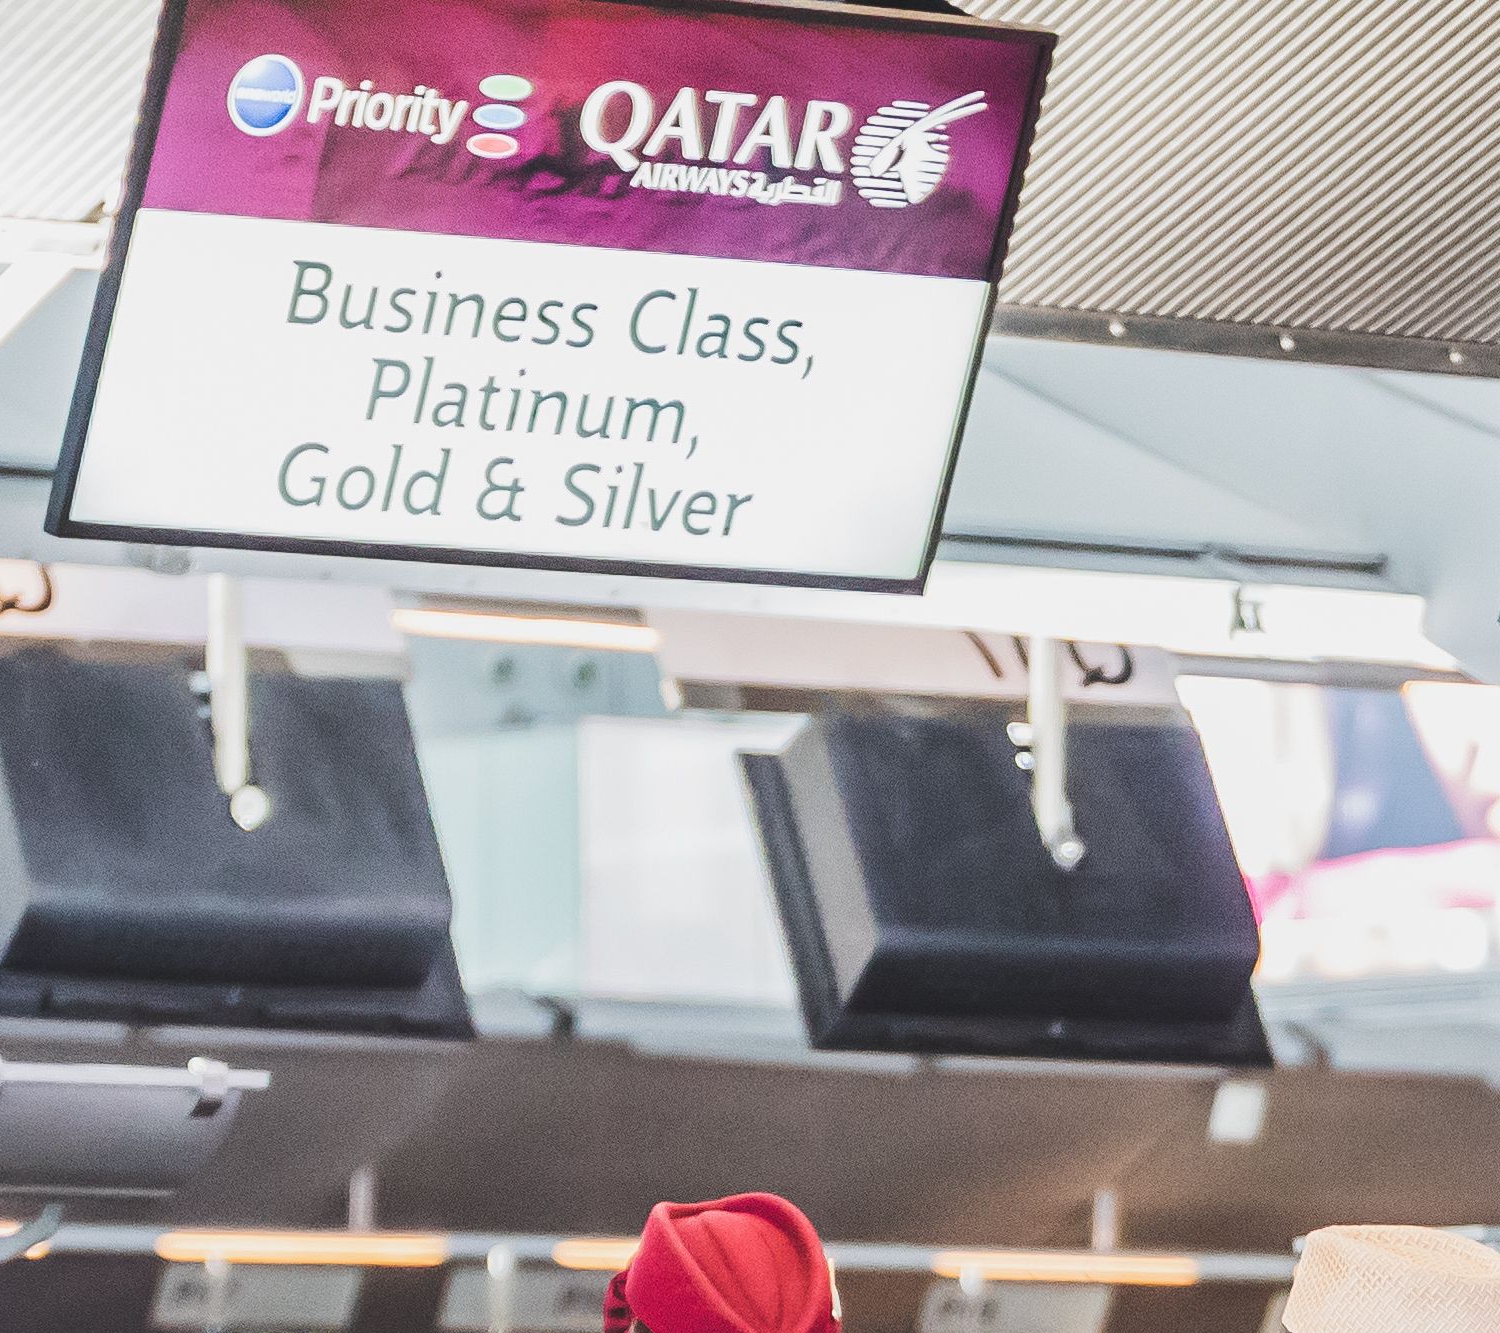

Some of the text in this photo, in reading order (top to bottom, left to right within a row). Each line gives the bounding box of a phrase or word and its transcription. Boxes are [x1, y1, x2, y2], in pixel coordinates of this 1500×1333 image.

[307, 76, 468, 144] Priority
[579, 80, 854, 173] QATAR
[631, 161, 749, 196] AIRWAYS
[286, 260, 814, 380] Business Class,
[365, 357, 699, 460] Platinum,
[277, 441, 754, 537] Gold & Silver
